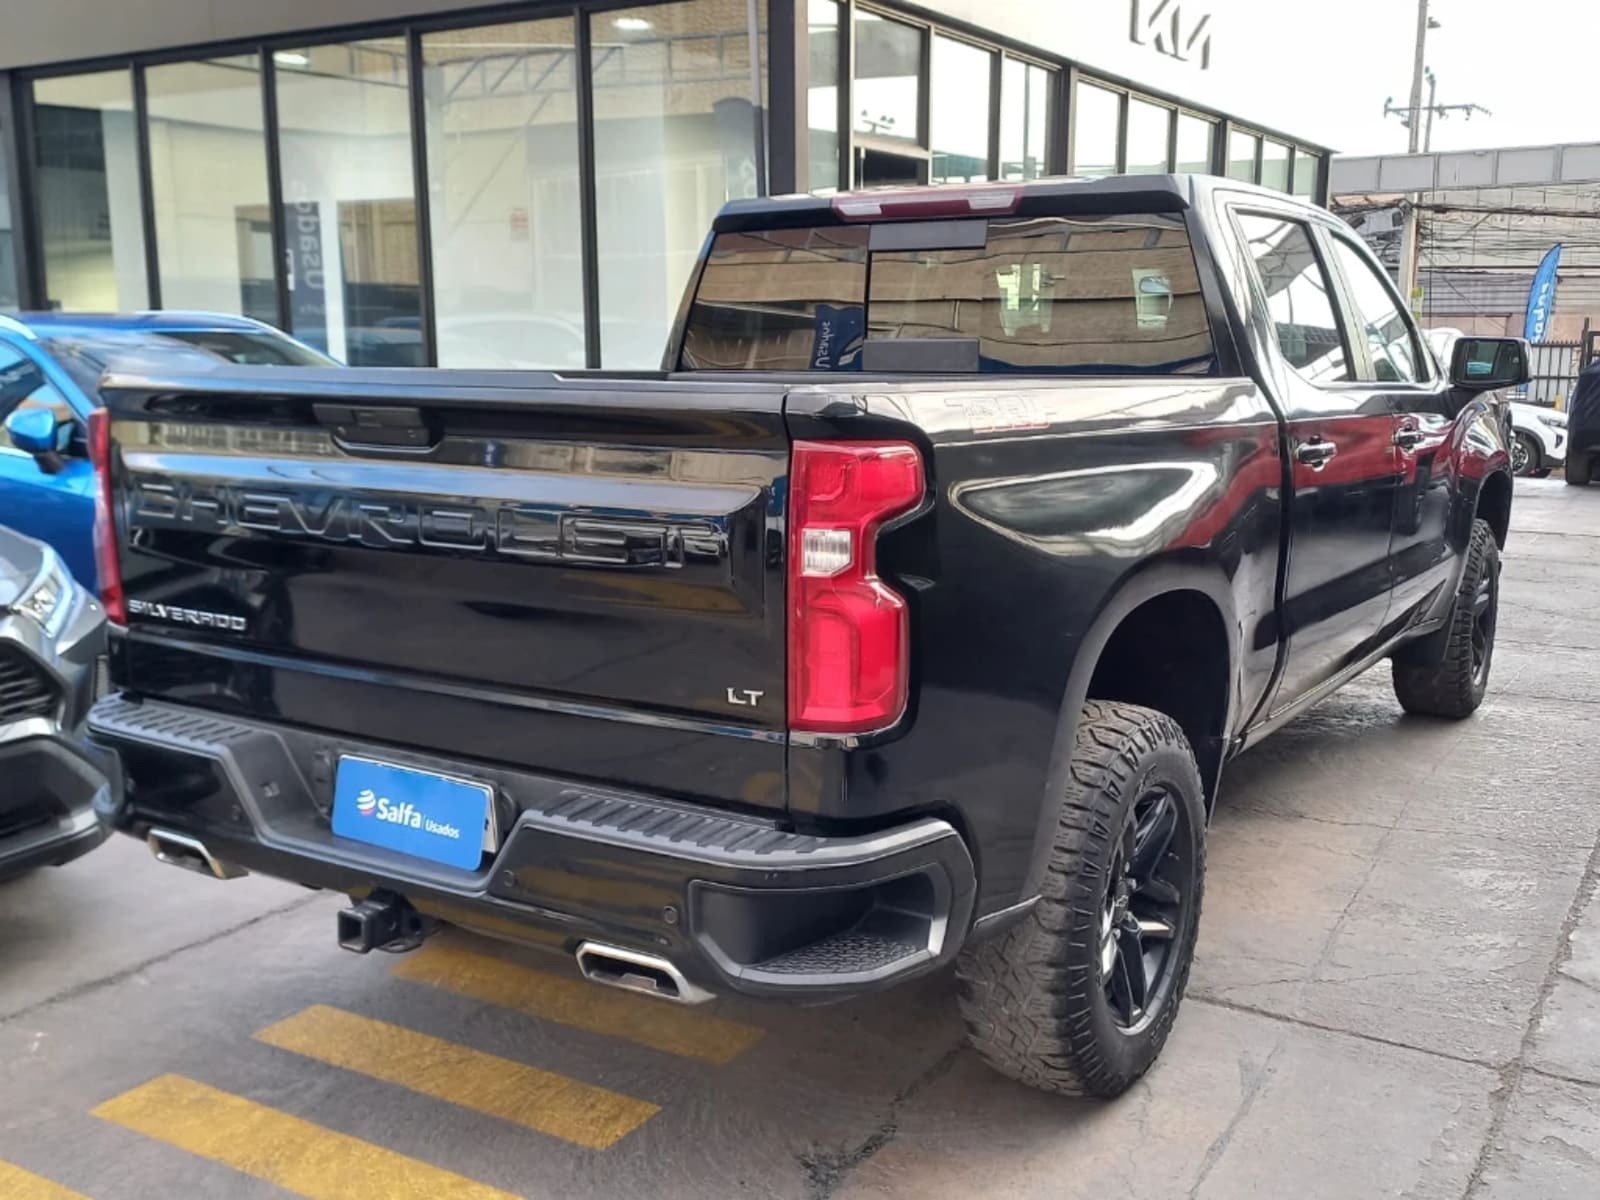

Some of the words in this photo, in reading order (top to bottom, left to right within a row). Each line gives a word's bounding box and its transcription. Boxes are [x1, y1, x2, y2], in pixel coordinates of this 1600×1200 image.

[127, 479, 730, 568] CHEVROLET
[128, 599, 246, 631] SILVERADO
[726, 687, 764, 707] LT
[375, 797, 422, 829] Salfa
[425, 818, 460, 840] Usados
